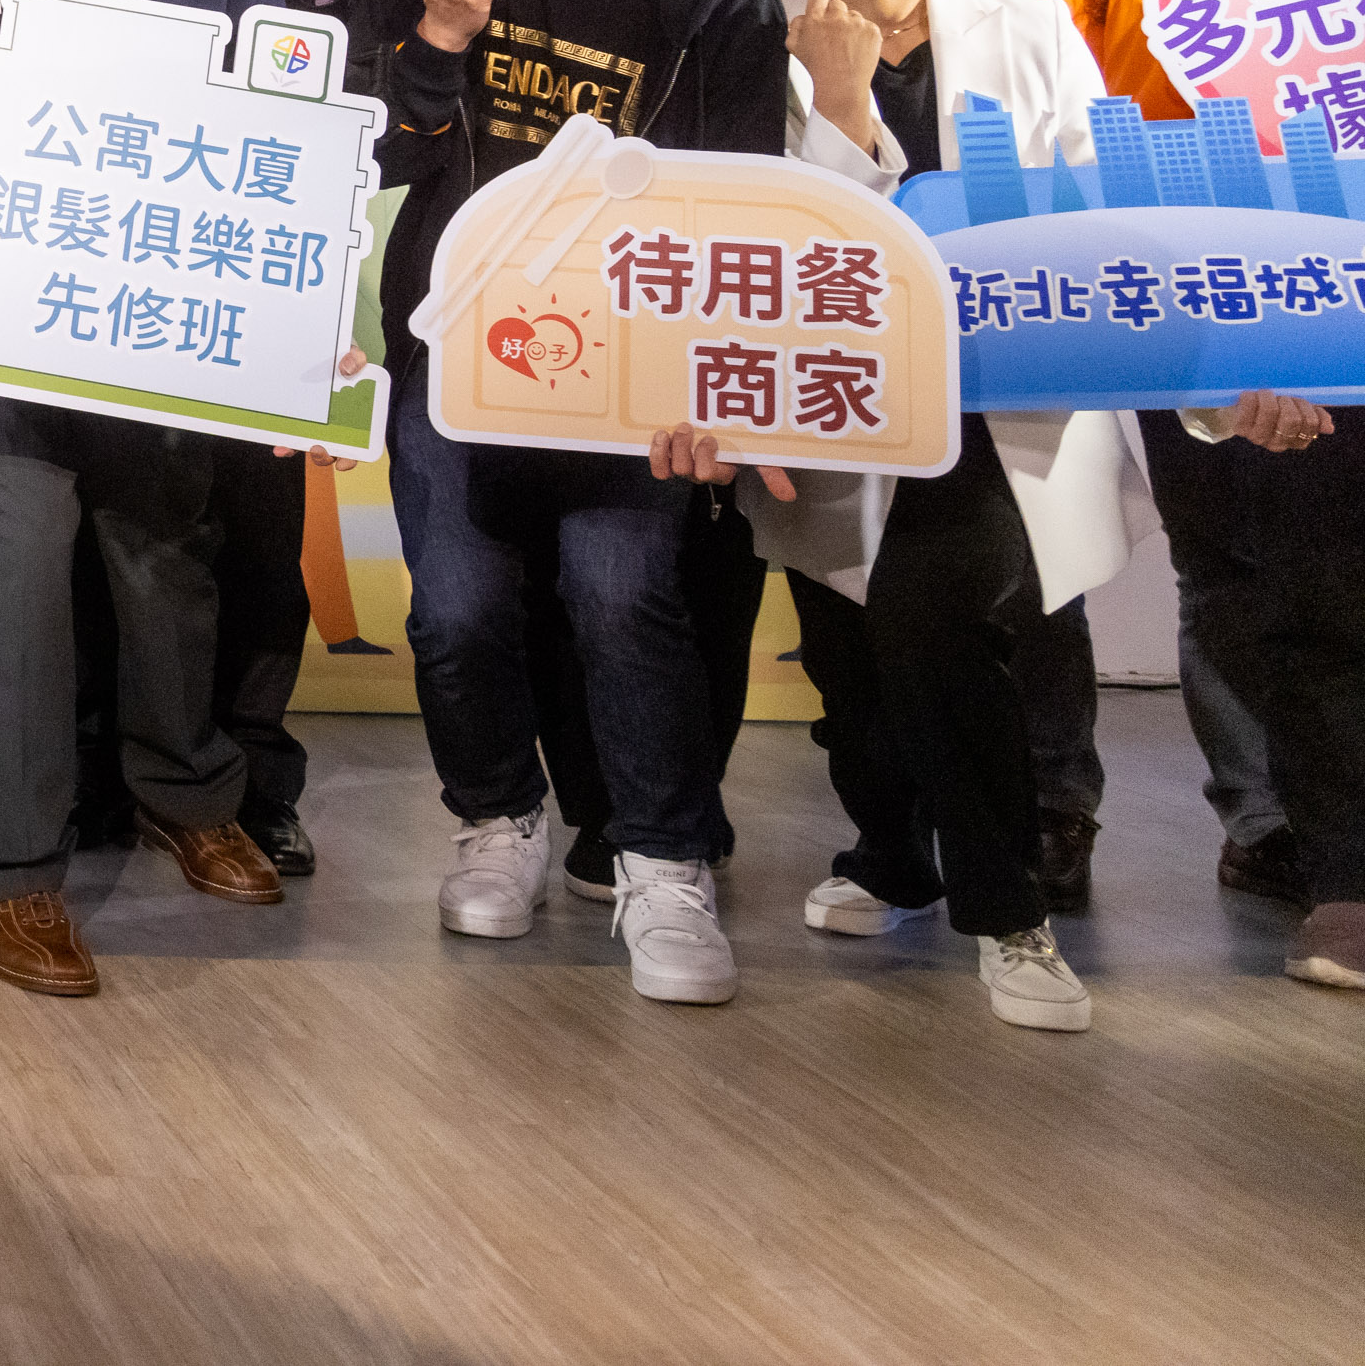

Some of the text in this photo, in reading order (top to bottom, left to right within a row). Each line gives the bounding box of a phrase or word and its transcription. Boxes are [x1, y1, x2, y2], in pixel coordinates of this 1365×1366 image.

[484, 50, 620, 123] ENDACE
[493, 98, 522, 113] ROMA
[24, 99, 301, 206] 公寓大廈
[35, 273, 246, 367] 先修班
[607, 231, 883, 329] 待用餐
[694, 341, 881, 432] 商家
[655, 869, 686, 877] CELINE
